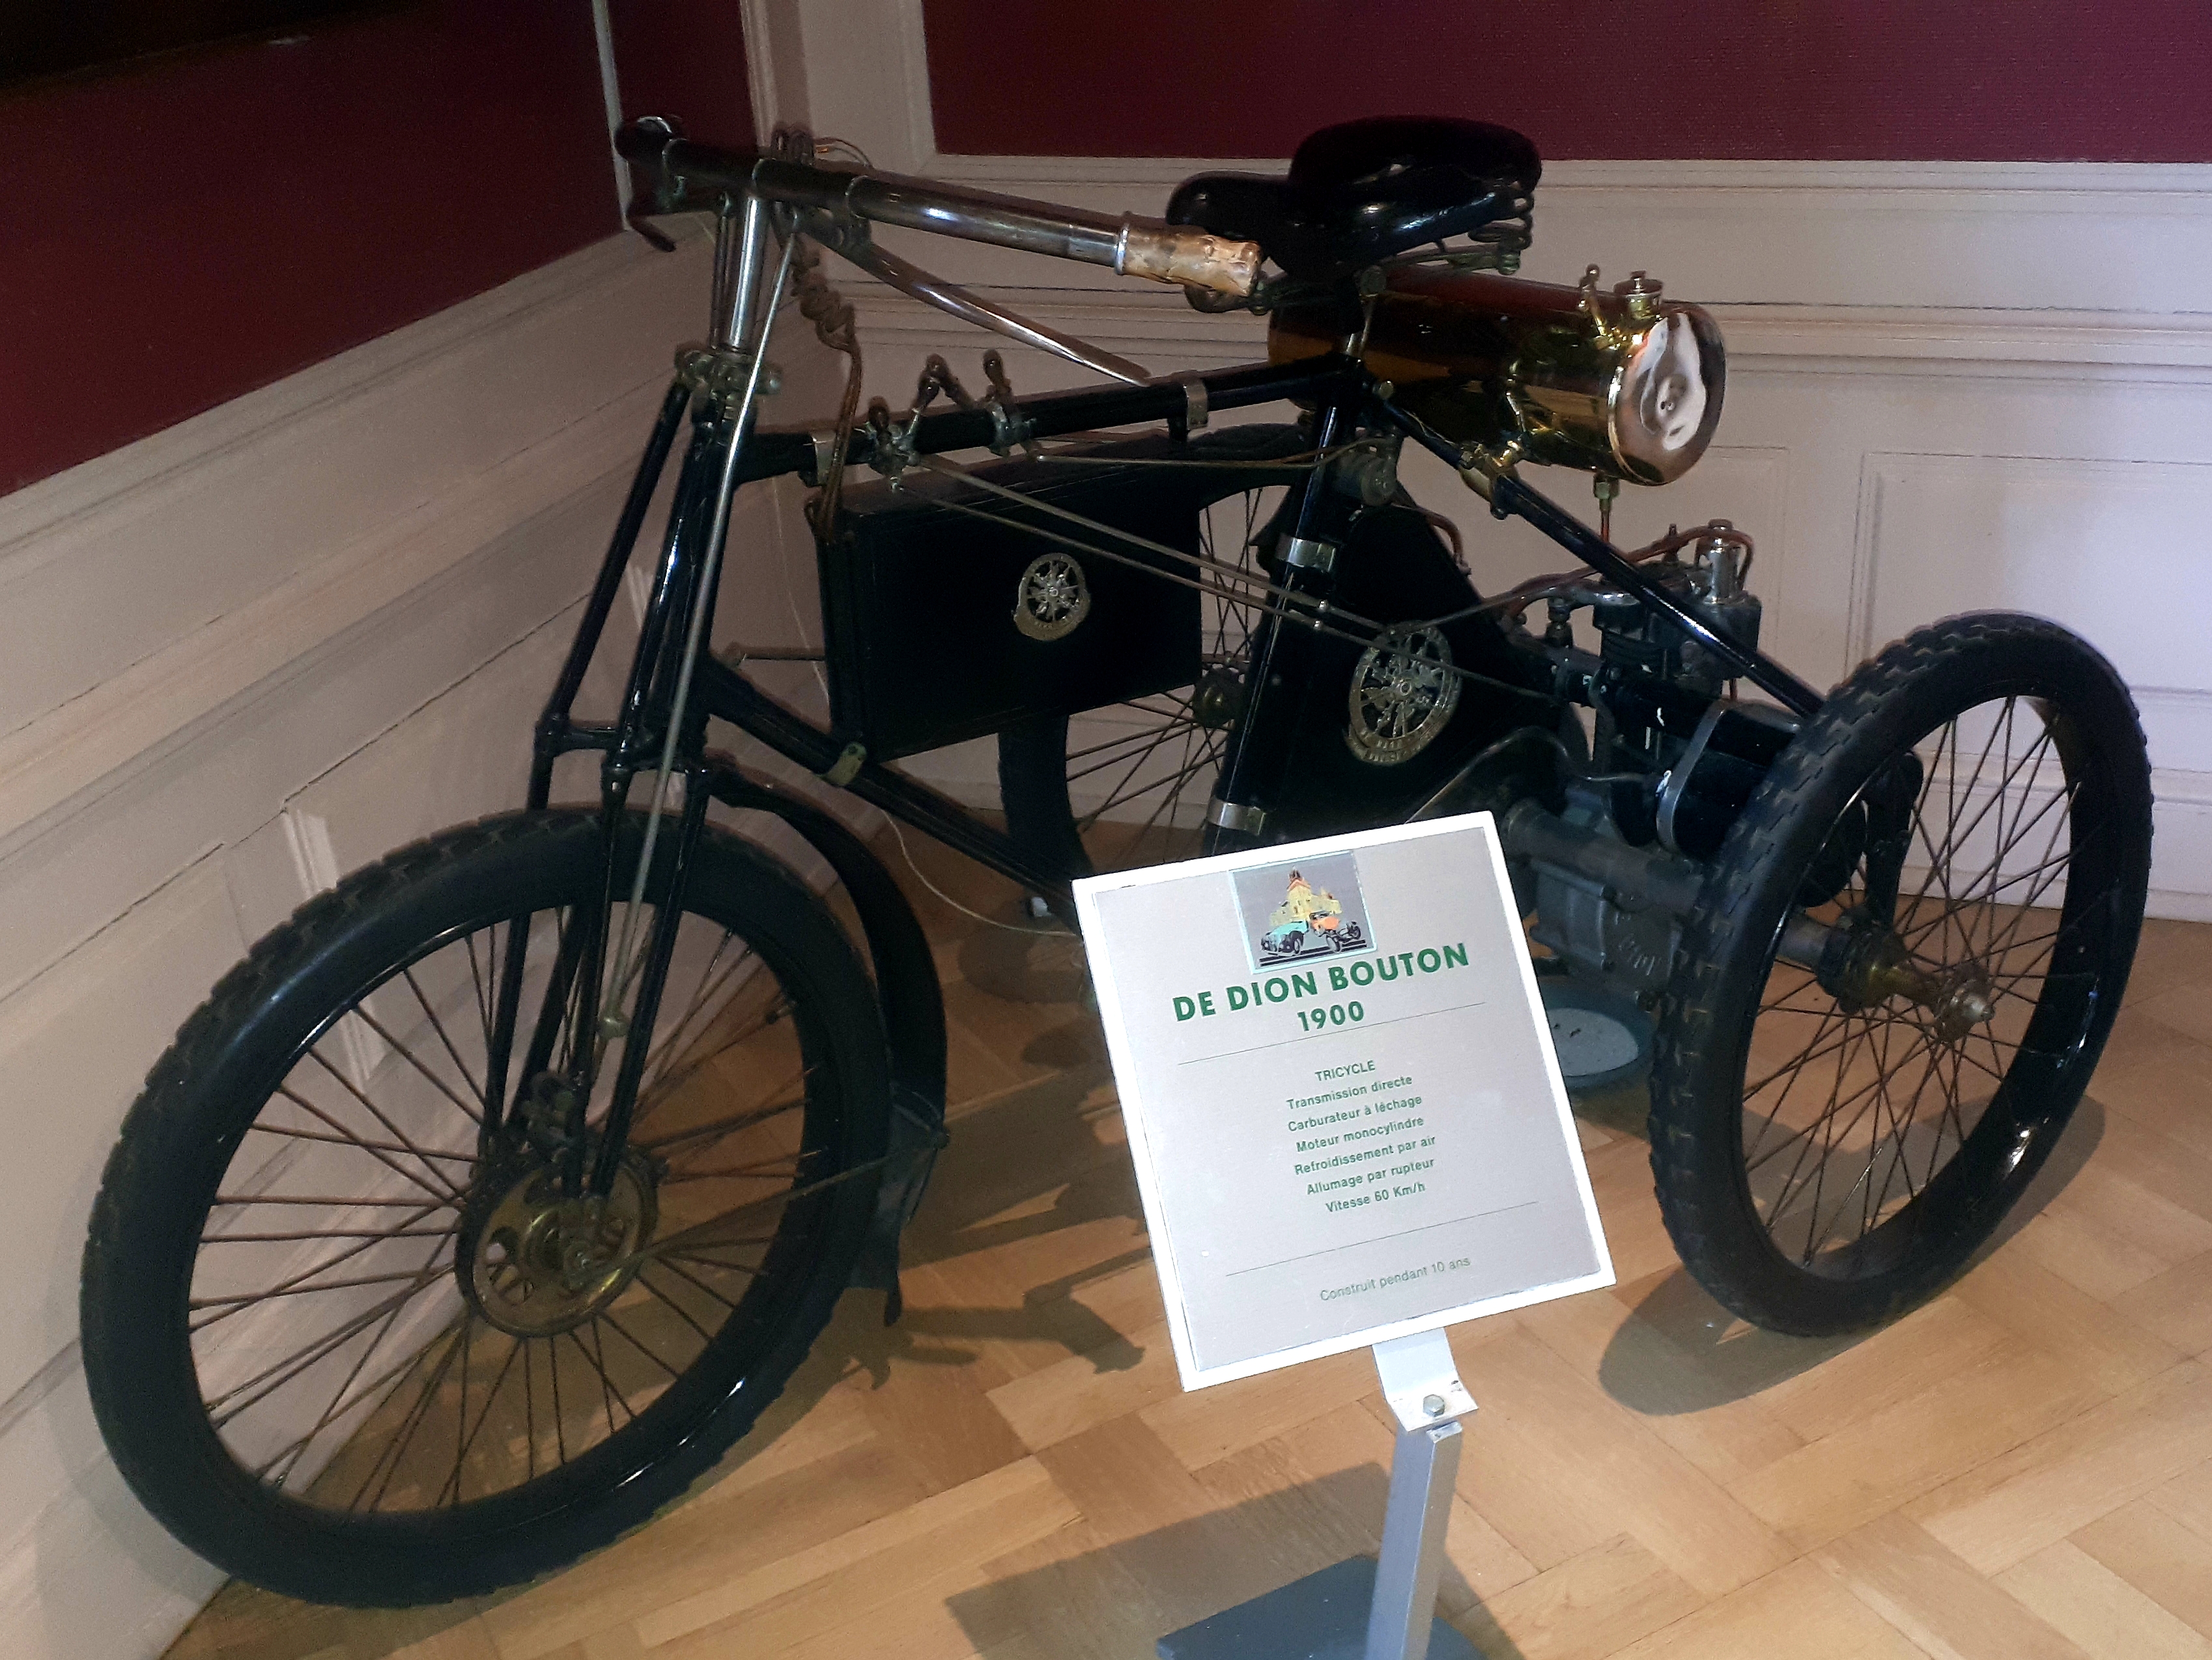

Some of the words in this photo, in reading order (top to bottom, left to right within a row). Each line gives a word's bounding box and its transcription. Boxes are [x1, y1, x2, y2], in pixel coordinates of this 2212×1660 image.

[1172, 990, 1217, 1022] DE
[1225, 971, 1318, 1012] DION
[1327, 942, 1469, 992] BOUTON
[1296, 1001, 1365, 1032] 1900
[1314, 1059, 1376, 1081] TRICYCLE
[1285, 1085, 1368, 1109] Transmission
[1371, 1074, 1413, 1093] directe
[1288, 1108, 1361, 1132] Carburateur
[1363, 1104, 1372, 1116] à
[1296, 1135, 1340, 1152] Moteur
[1343, 1116, 1425, 1143] monocylindre
[1294, 1144, 1395, 1176] Refroidissement
[1397, 1141, 1417, 1154] par
[1420, 1136, 1436, 1147] air
[1306, 1174, 1364, 1195] Allumage
[1367, 1169, 1387, 1184] par
[1390, 1158, 1435, 1177] rupteur
[1324, 1194, 1372, 1213] Vitesse
[1374, 1189, 1390, 1203] 60
[1392, 1182, 1426, 1198] Km/h
[1320, 1278, 1376, 1301] Construit
[1380, 1266, 1428, 1289] pendant
[1432, 1261, 1445, 1274] 10
[1449, 1257, 1471, 1270] ans
